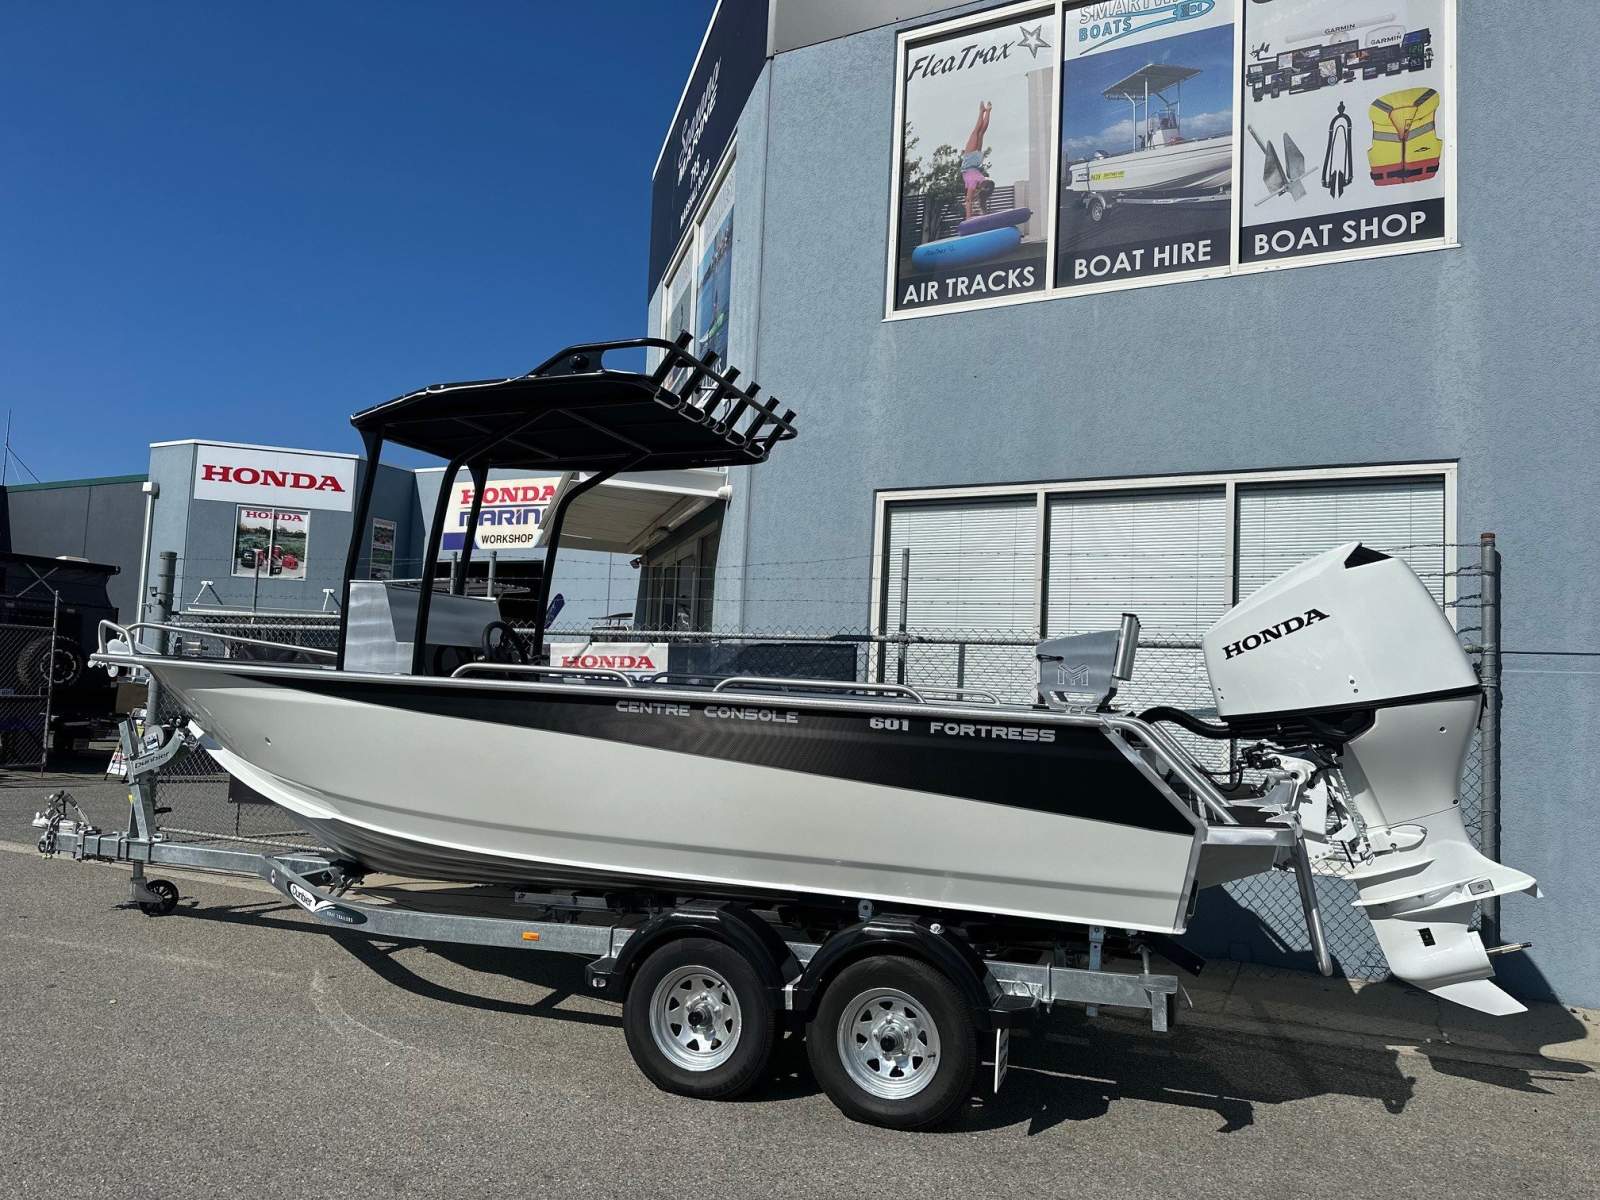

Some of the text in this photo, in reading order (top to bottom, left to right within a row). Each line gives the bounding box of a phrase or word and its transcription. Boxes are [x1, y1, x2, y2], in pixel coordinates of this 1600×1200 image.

[1079, 17, 1132, 42] BOATS
[1324, 23, 1356, 35] GARMIN
[1370, 34, 1402, 45] GARMIN
[1253, 211, 1428, 256] BOAT SHOP
[1073, 240, 1212, 280] BOAT HIRE
[902, 266, 1035, 305] AIR TRACKS
[201, 464, 346, 493] HONDA
[245, 510, 304, 522] HONDA
[481, 533, 534, 544] WORKSHOP
[1222, 608, 1331, 660] HONDA
[562, 655, 656, 670] HONDA
[615, 699, 799, 724] CENTRE CONSOLE
[869, 716, 1056, 743] 601 FORTRESS
[290, 885, 313, 907] Dunbier
